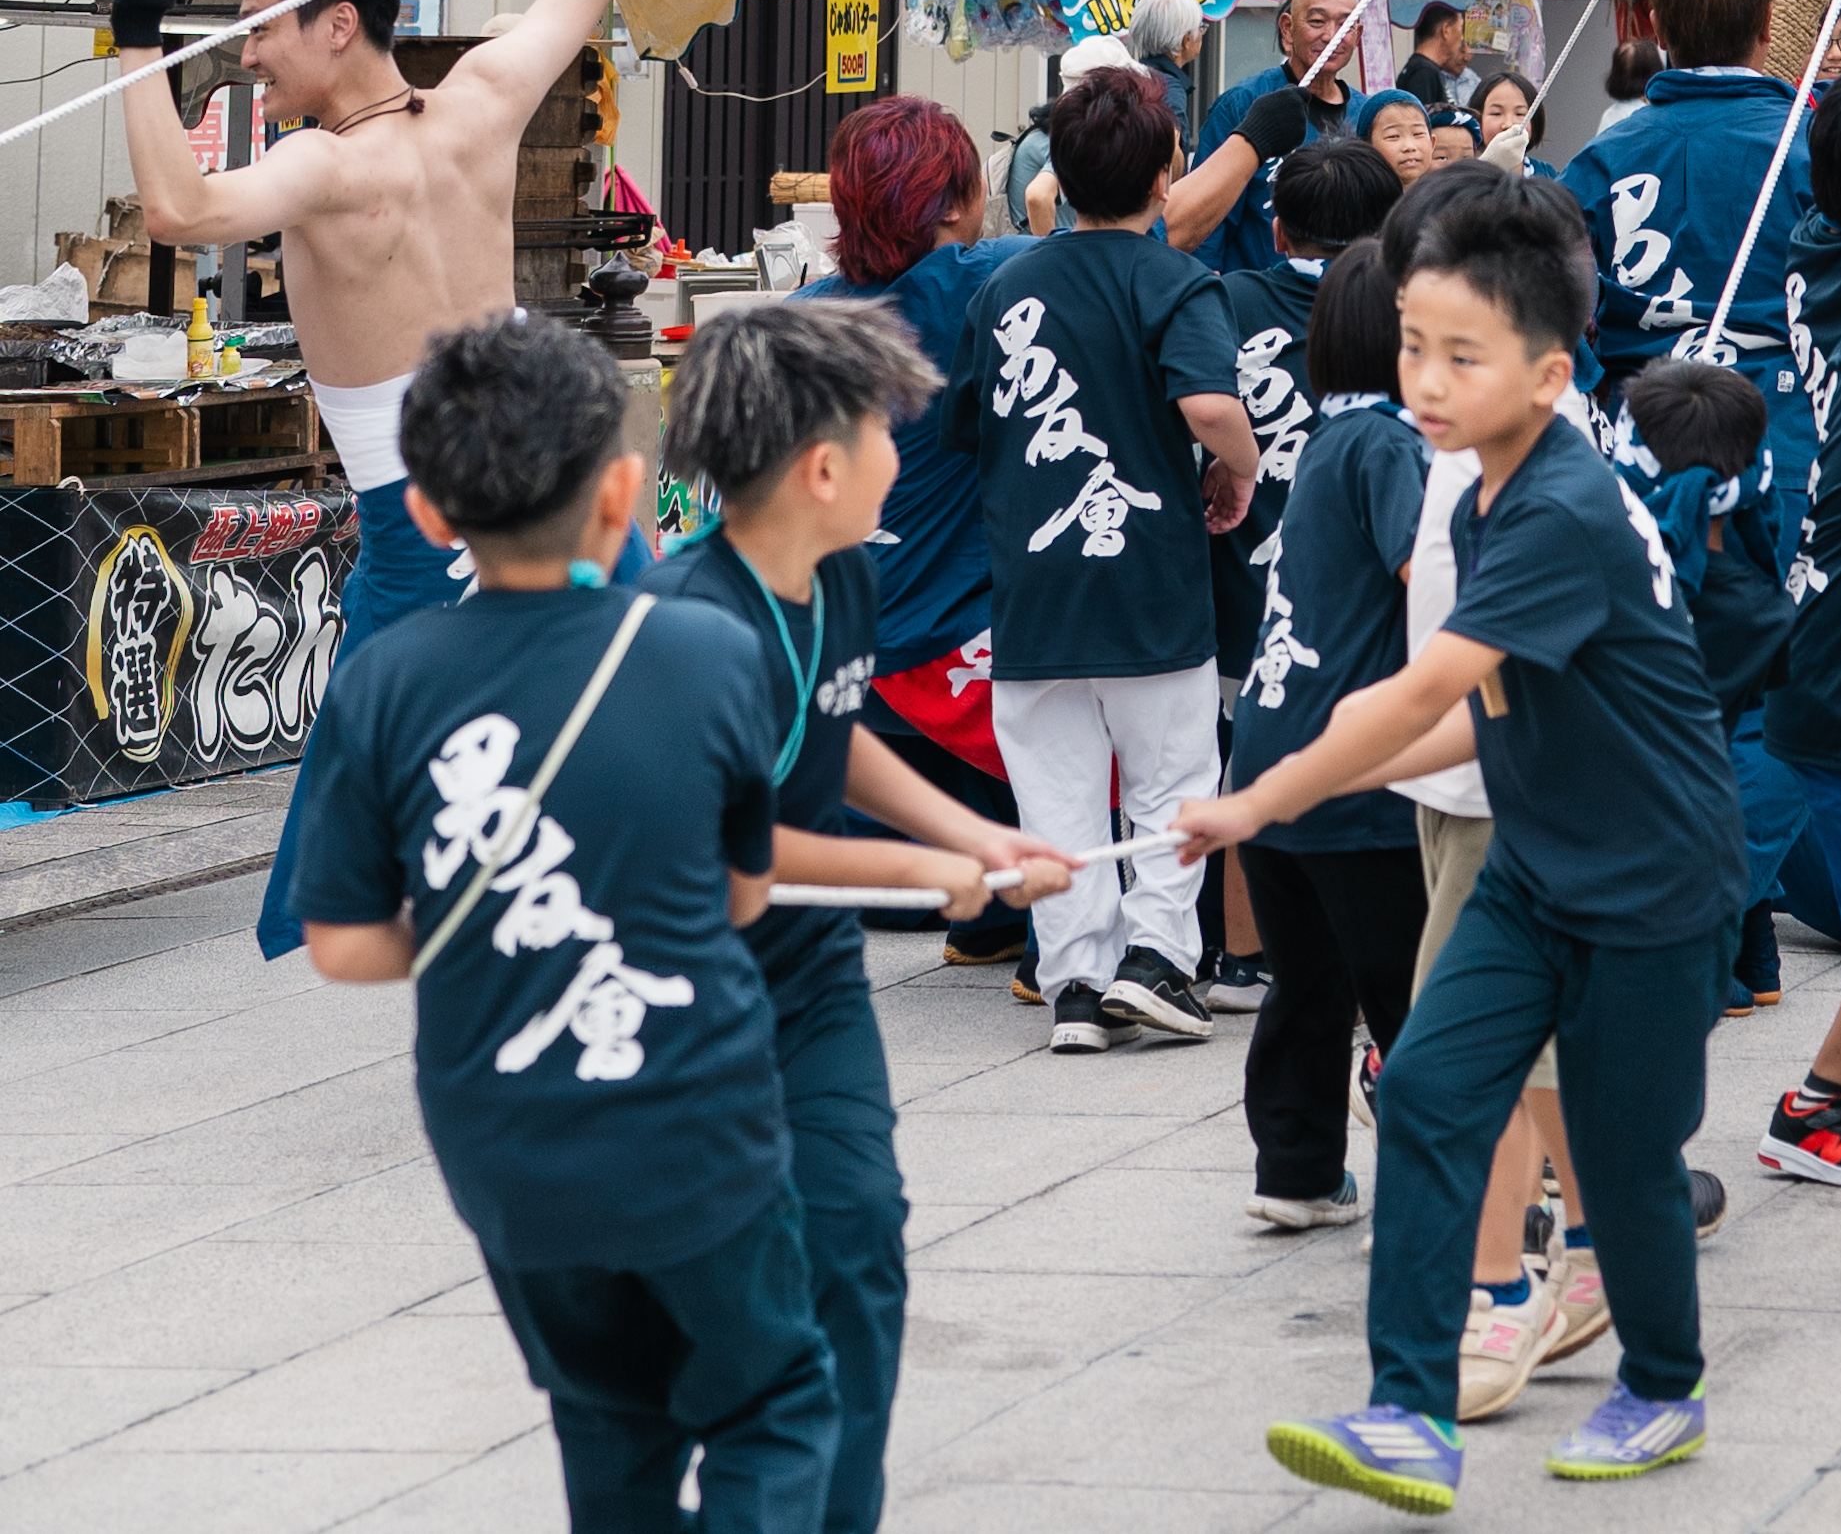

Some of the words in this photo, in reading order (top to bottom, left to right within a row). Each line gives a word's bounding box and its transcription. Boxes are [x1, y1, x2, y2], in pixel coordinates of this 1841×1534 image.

[829, 2, 878, 36] じゃがバター
[841, 53, 864, 75] 500円
[110, 535, 172, 751] 特選
